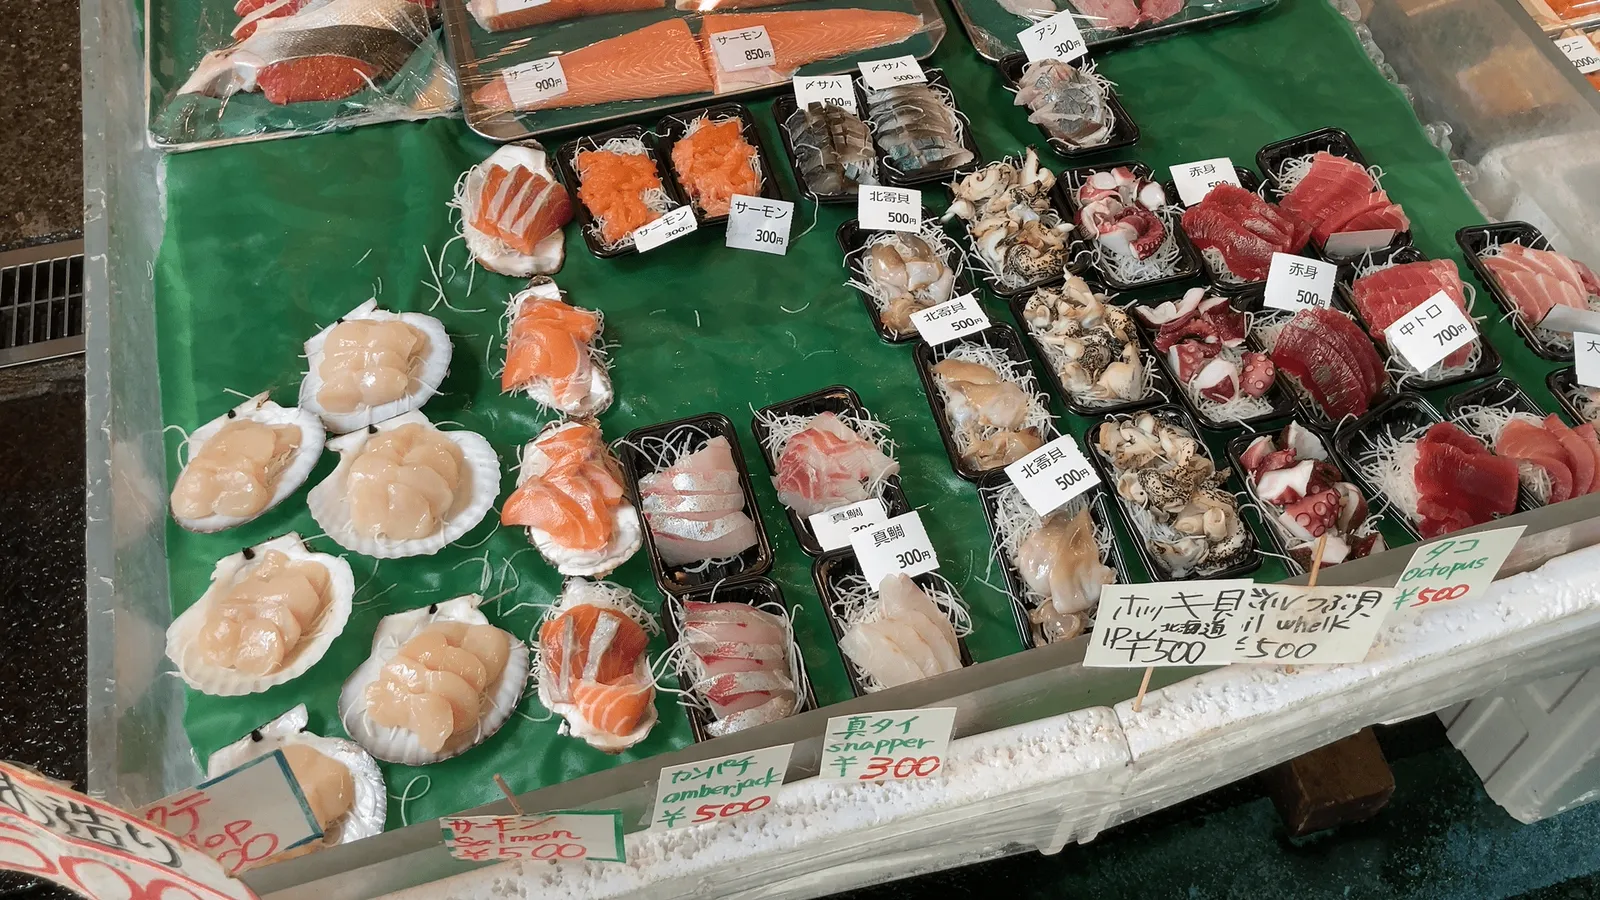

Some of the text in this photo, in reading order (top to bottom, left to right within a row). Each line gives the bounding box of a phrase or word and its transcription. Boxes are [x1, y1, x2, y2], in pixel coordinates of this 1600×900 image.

[716, 31, 763, 46] サーモン
[1035, 22, 1057, 41] アジ
[744, 48, 771, 61] 850円
[1053, 40, 1081, 57] 300円
[509, 61, 555, 79] サーモン
[535, 77, 562, 92] 900円
[1189, 164, 1216, 178] 赤身
[869, 190, 911, 205] 北寄貝
[735, 201, 788, 219] サーモン
[888, 212, 917, 225] 500円
[637, 210, 688, 237] サーモン
[755, 229, 784, 245] 300円
[1288, 262, 1318, 280] 赤身
[1296, 289, 1326, 309] 500円
[923, 302, 967, 323] 北寄貝
[1400, 304, 1443, 337] 中トロ
[951, 317, 983, 332] 500円
[1433, 323, 1468, 347] 700円
[1020, 446, 1067, 479] 北寄貝
[1054, 468, 1090, 491] 500円
[871, 523, 906, 547] 真鯛
[895, 548, 931, 569] 300円
[1424, 539, 1480, 564] タコ
[1113, 589, 1246, 621] ホッキ貝
[1160, 618, 1227, 639] 北海道
[1276, 614, 1350, 634] whelk
[832, 716, 919, 740] 真タイ
[825, 738, 935, 755] snapper
[662, 767, 782, 804] amberjack
[448, 816, 556, 833] サーモン
